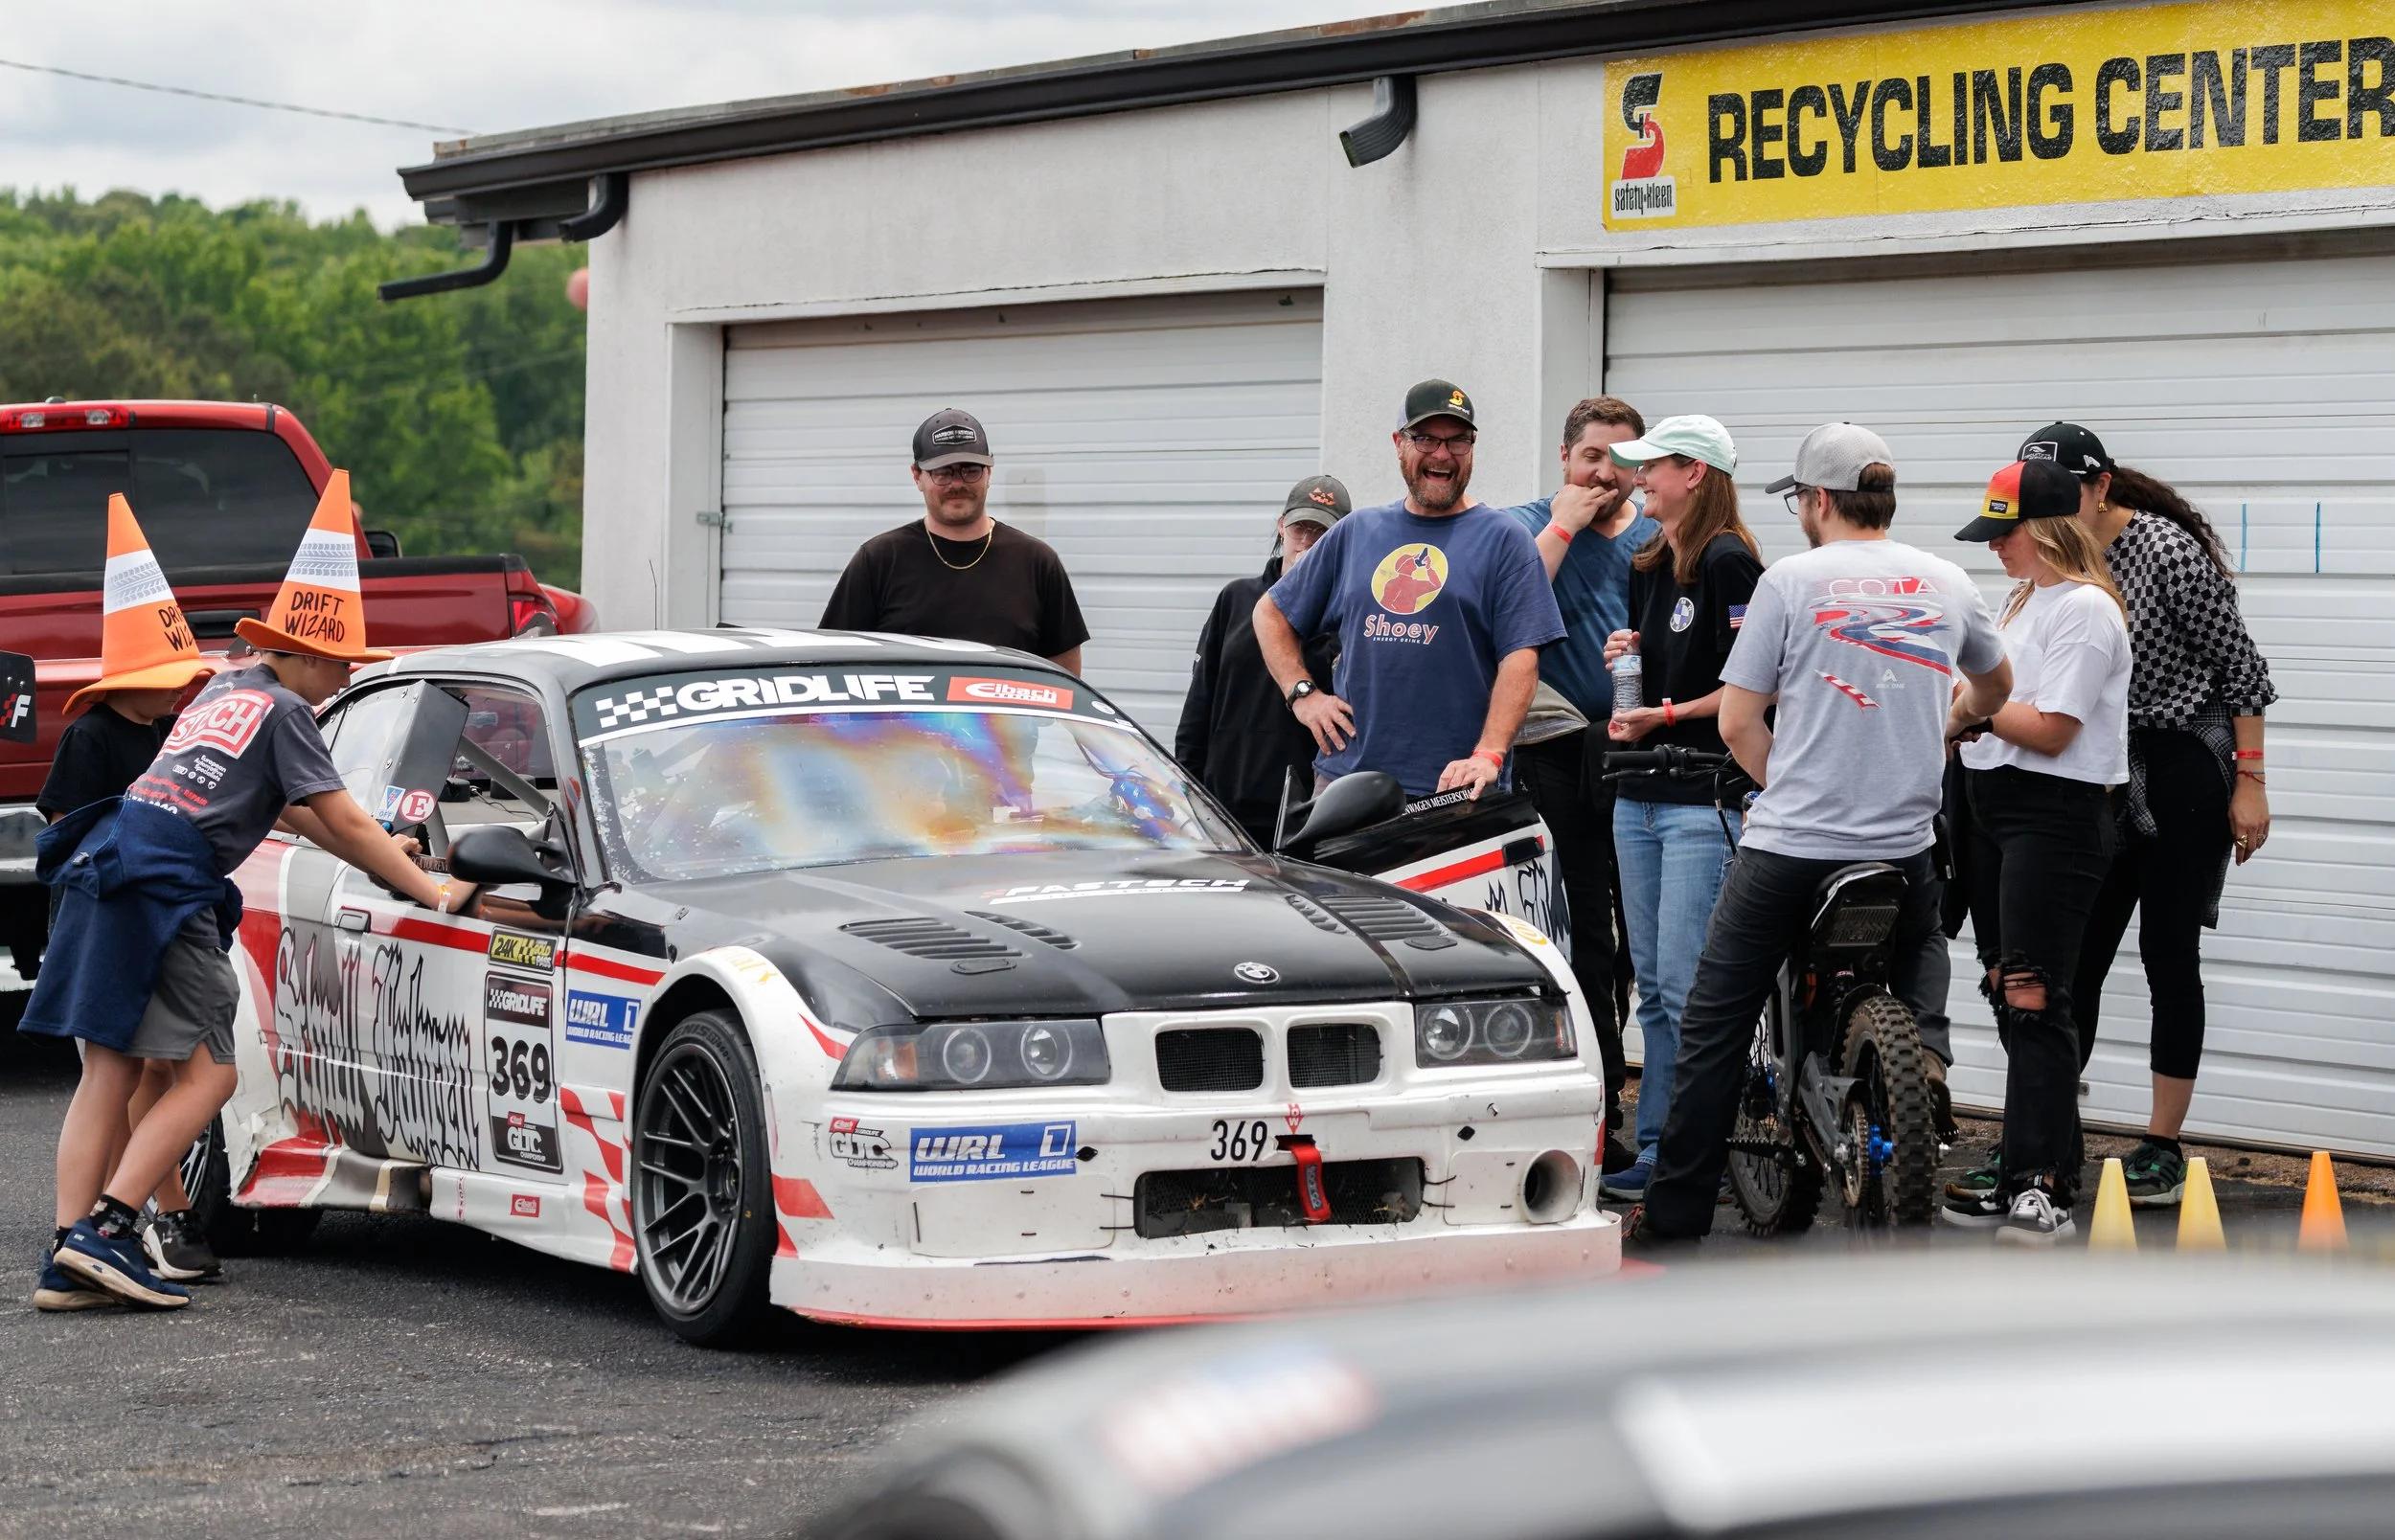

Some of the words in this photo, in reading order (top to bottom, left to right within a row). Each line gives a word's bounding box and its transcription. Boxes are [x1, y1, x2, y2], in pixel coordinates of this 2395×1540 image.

[1707, 62, 2075, 184] RECYCLING
[2096, 36, 2395, 155] CENTER
[1828, 578, 1939, 596] COTA
[290, 590, 345, 616] DRIFT
[158, 604, 183, 628] DRI
[285, 613, 346, 643] WIZARD
[164, 625, 194, 652] WIZ
[1363, 613, 1439, 645] Shoey
[675, 674, 936, 712] GRIDLIFE
[965, 683, 1059, 704] Eibach
[194, 758, 224, 778] Automotive
[194, 763, 221, 782] Specialists
[200, 754, 227, 774] European
[183, 789, 208, 806] REPAIR
[406, 794, 430, 819] E
[1403, 799, 1432, 815] NWAGEN
[1430, 788, 1474, 808] MEISTERSCHA
[378, 810, 392, 819] OFF
[1006, 878, 1250, 897] FASTECH
[493, 937, 518, 958] 24K
[533, 943, 552, 956] GOLD
[536, 955, 552, 968] PASS
[501, 990, 548, 1017] GRIDLIFE
[567, 998, 609, 1028] WRL
[566, 1025, 589, 1038] WORLD
[589, 1029, 615, 1042] RACING
[615, 1032, 632, 1045] LEAG
[490, 1035, 553, 1104] 369
[914, 1134, 1006, 1163] WRL
[1210, 1120, 1268, 1162] 369
[913, 1164, 966, 1177] WORLD
[966, 1162, 1021, 1176] RACING
[1022, 1158, 1075, 1172] LEAGUE
